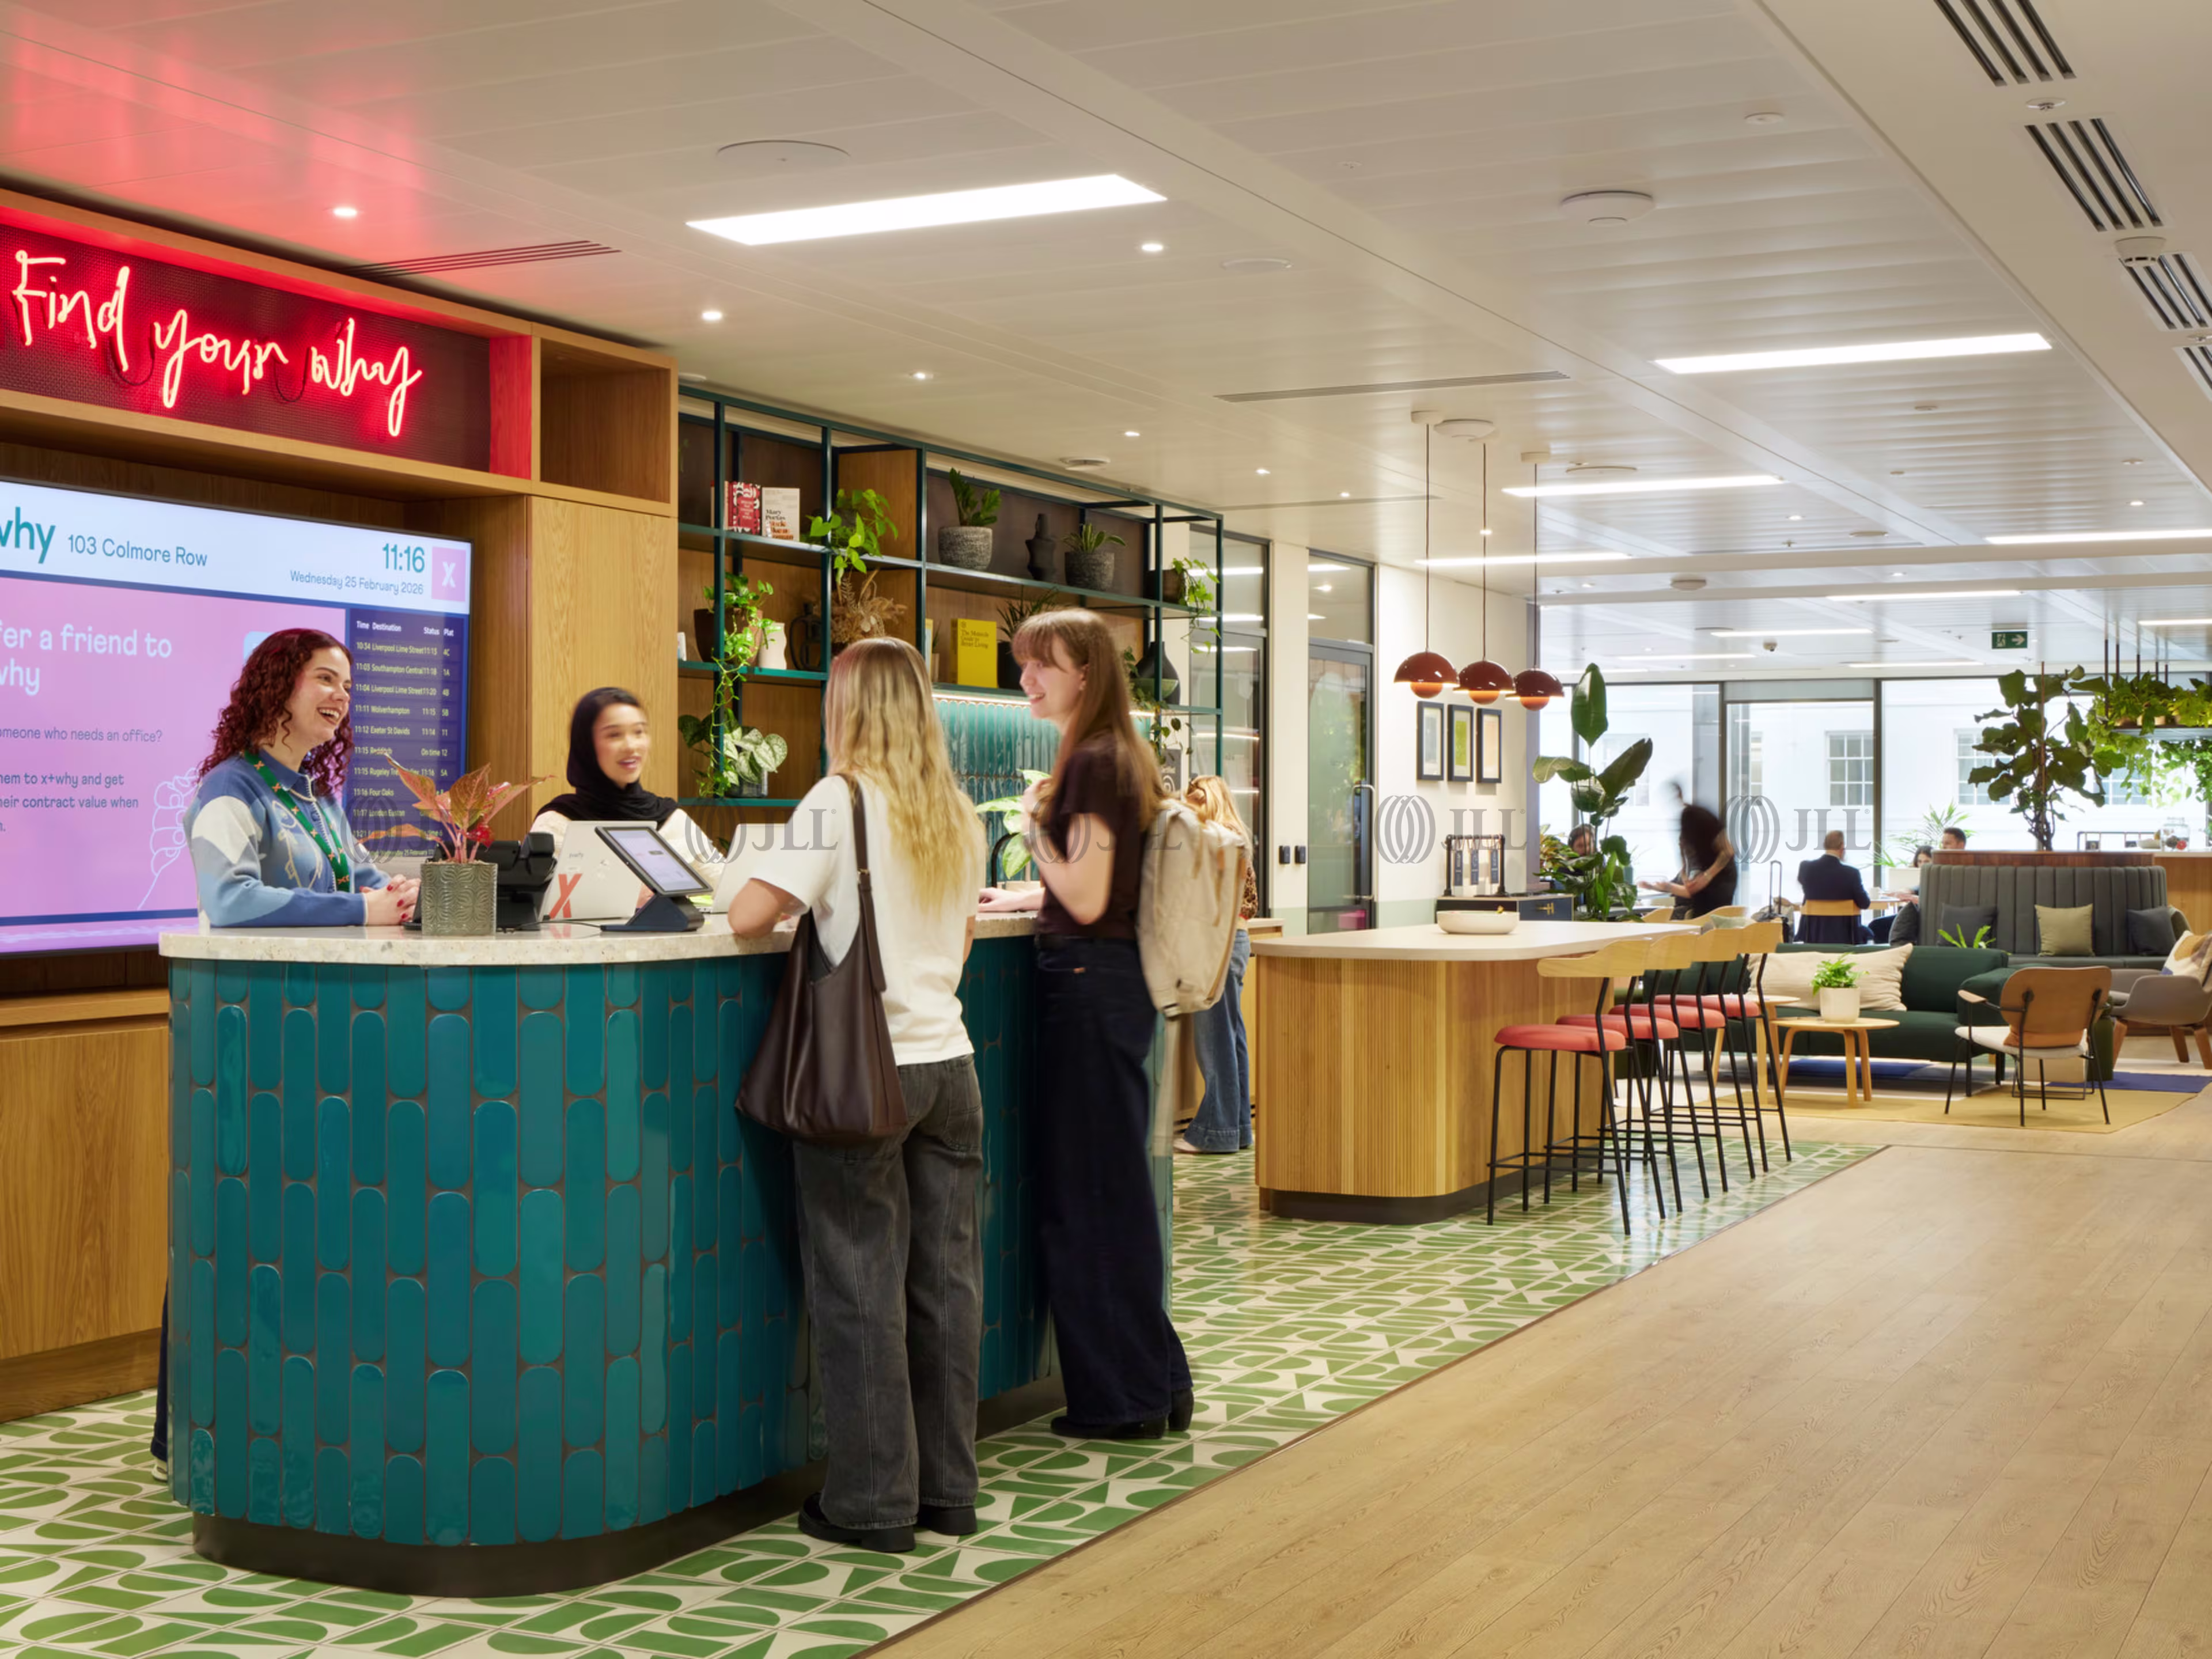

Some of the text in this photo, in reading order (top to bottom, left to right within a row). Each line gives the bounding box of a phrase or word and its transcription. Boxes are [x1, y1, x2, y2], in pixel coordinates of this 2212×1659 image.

[12, 249, 422, 437] Find your why
[68, 534, 208, 567] 103 Colmore Row
[382, 543, 425, 573] 11:16
[290, 570, 424, 596] Wednesday 25 February 2026
[356, 620, 454, 637] Time Destination Status Plat
[0, 619, 172, 658] er a friend to
[372, 643, 395, 653] Liverpool
[396, 645, 408, 654] Lime
[371, 664, 406, 675] Southampton
[371, 684, 395, 695] Liverpool
[355, 704, 369, 713] 11:11
[44, 726, 68, 740] who
[70, 728, 104, 741] needs
[107, 730, 119, 742] an
[122, 729, 163, 743] office?
[355, 725, 369, 734] 11:12
[370, 726, 387, 735] Exeter
[387, 726, 393, 734] St
[393, 727, 410, 736] Davids
[421, 748, 429, 756] On
[429, 748, 441, 756] time
[441, 749, 448, 757] 12
[370, 767, 389, 777] Rugeley
[0, 772, 124, 789] em to x+why and get
[369, 788, 381, 797] Four
[381, 789, 395, 797] Oaks
[22, 796, 75, 808] contract
[78, 796, 108, 808] value
[111, 796, 139, 809] when
